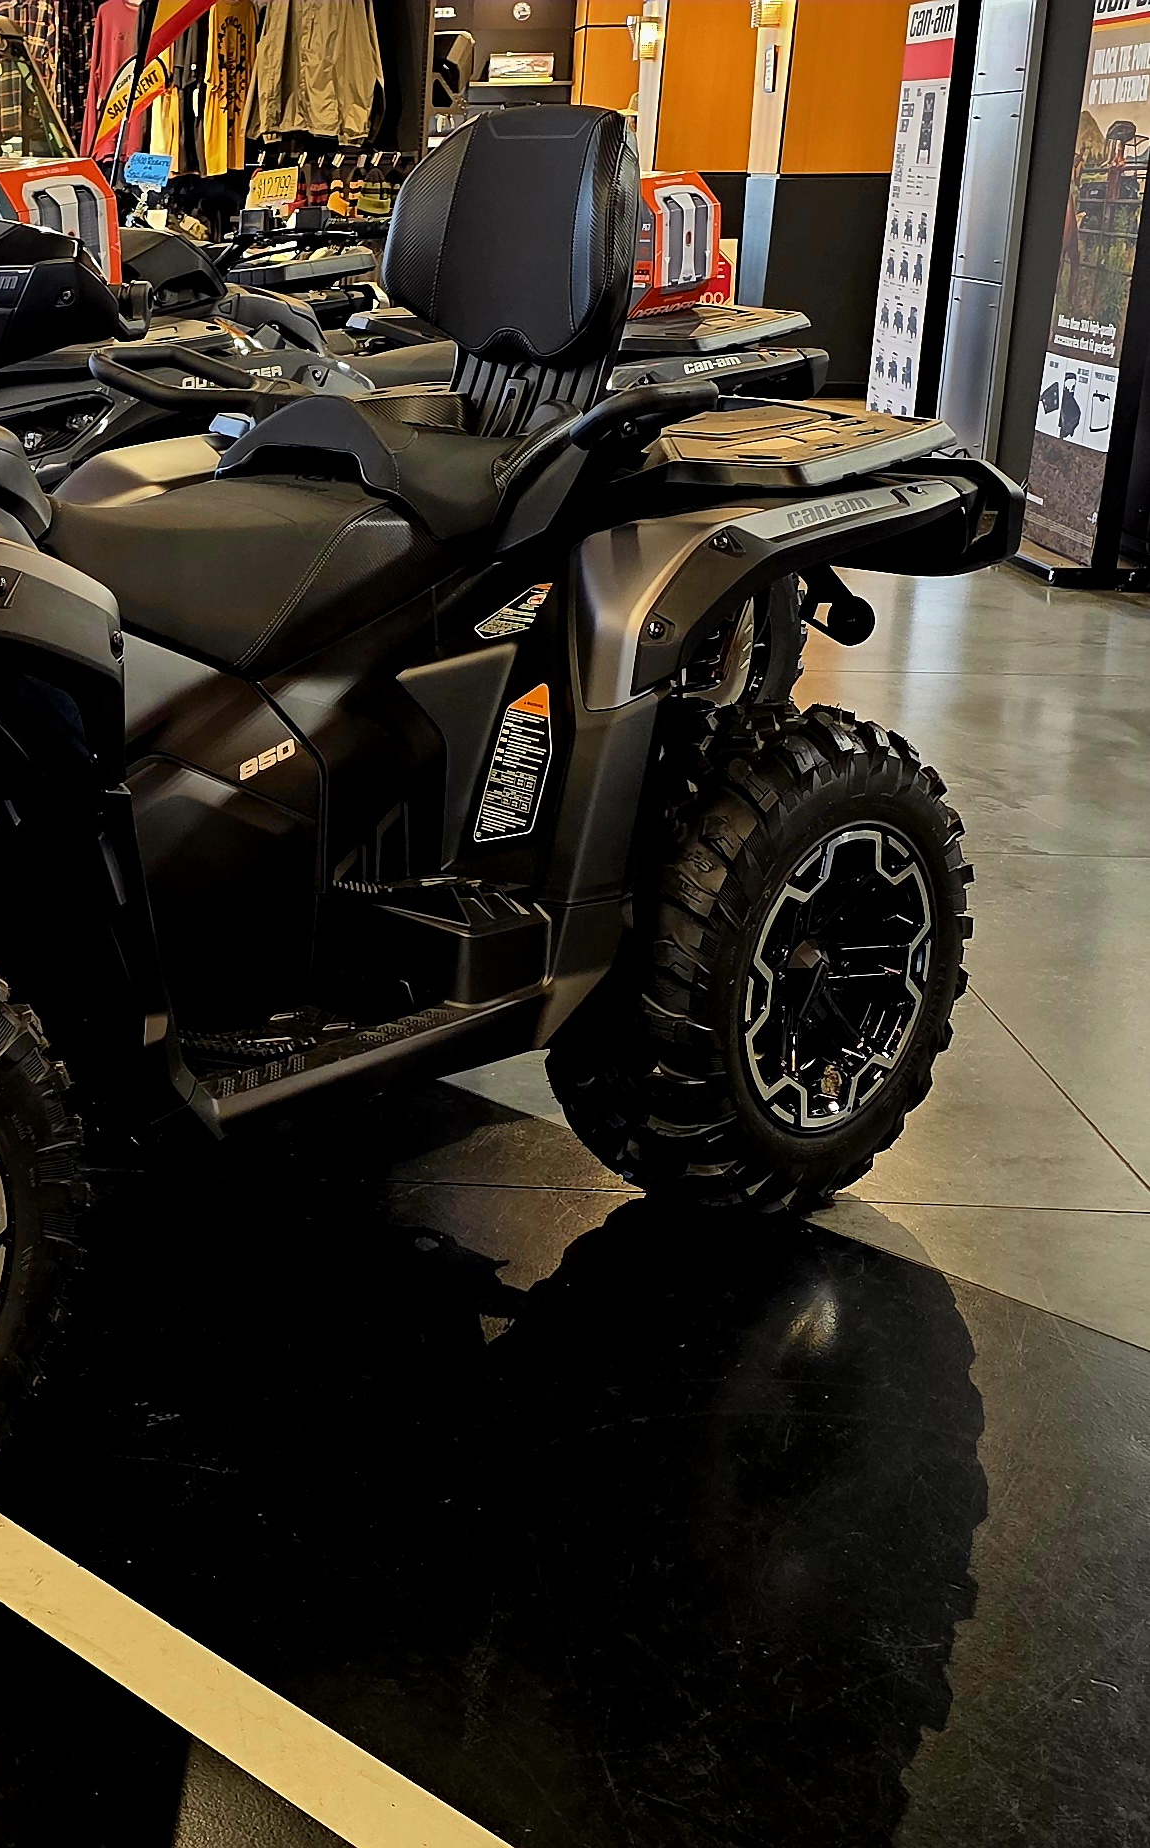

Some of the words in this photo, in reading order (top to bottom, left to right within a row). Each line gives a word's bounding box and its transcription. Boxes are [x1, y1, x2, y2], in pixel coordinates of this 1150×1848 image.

[909, 4, 955, 37] can-am
[134, 70, 159, 100] VENT
[683, 356, 742, 375] can-am
[787, 497, 873, 529] can-am
[239, 738, 296, 780] 850
